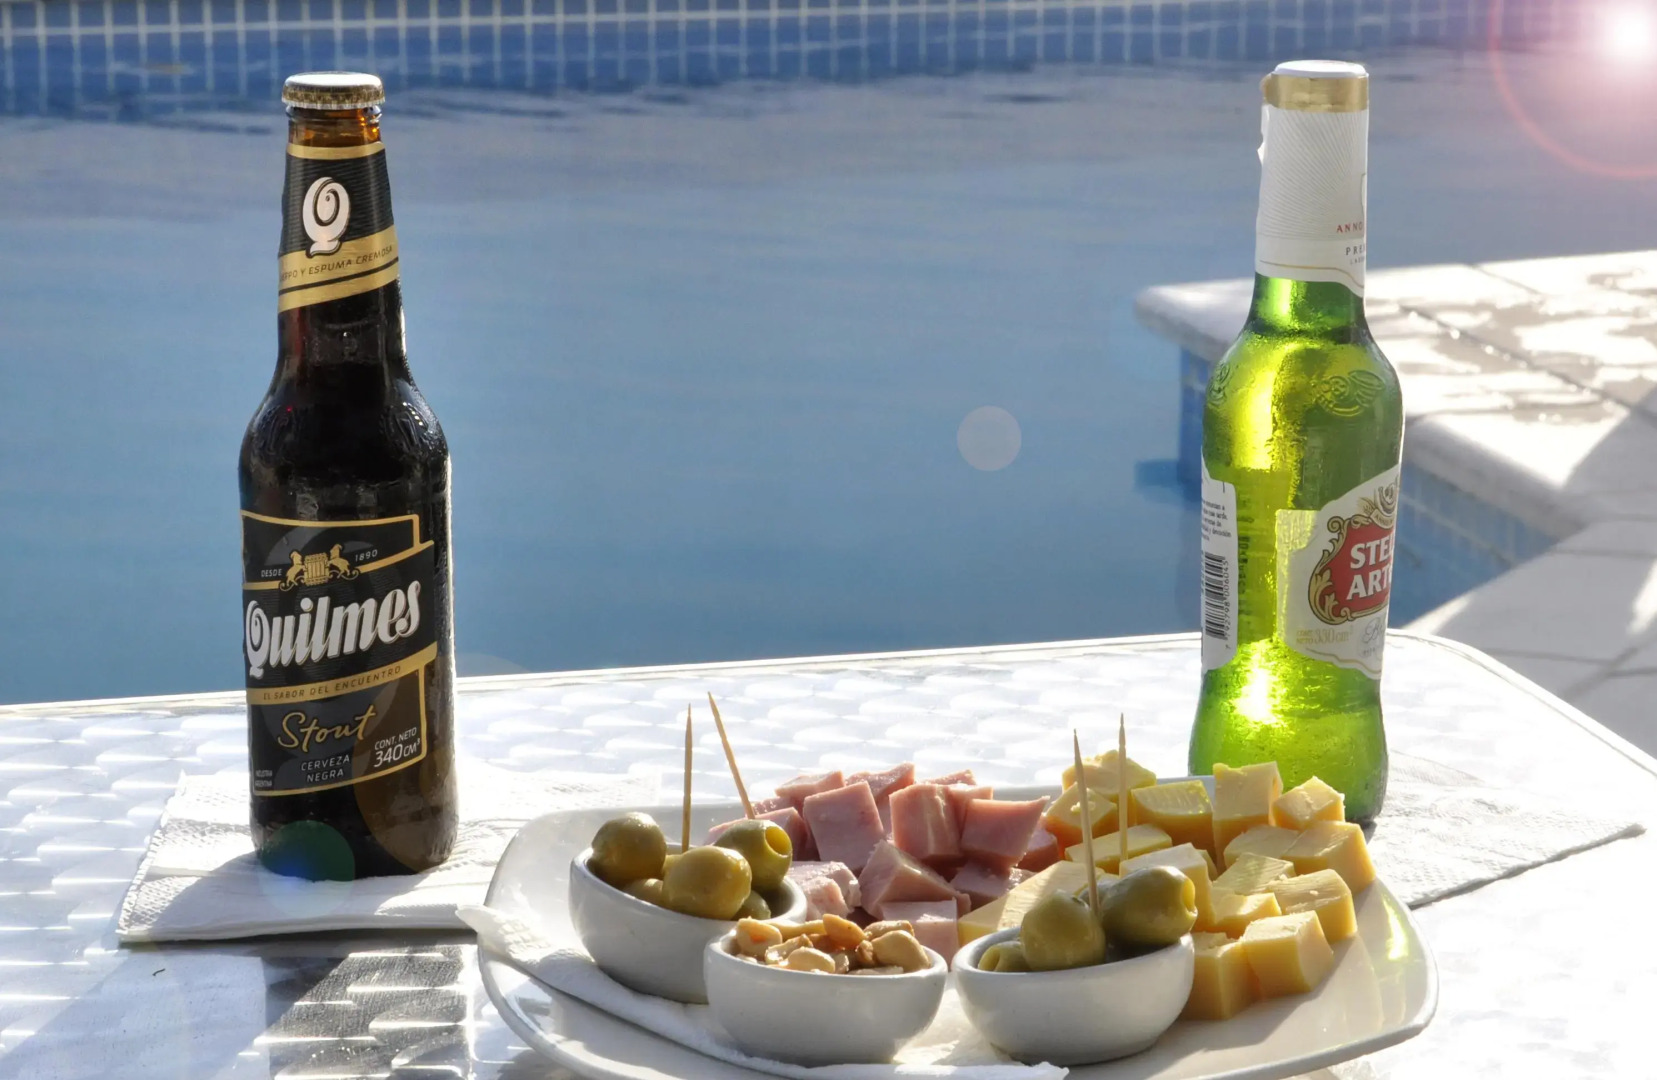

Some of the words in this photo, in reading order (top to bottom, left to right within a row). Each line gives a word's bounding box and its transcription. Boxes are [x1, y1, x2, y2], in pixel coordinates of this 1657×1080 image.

[300, 267, 306, 277] Y
[308, 259, 352, 275] ESPUMA
[355, 245, 393, 265] CREMOSA
[354, 549, 378, 562] 1890
[260, 568, 282, 578] DESDE
[1222, 560, 1230, 597] 006045
[245, 580, 422, 679] Quilmes
[273, 689, 305, 700] SABOR
[310, 686, 329, 696] DEL
[335, 666, 401, 692] ENCUENTRO
[277, 704, 377, 753] Stout
[374, 735, 397, 750] CONT.
[398, 727, 418, 742] NETO
[301, 754, 350, 772] CERVEZA
[306, 768, 345, 783] NEGRA
